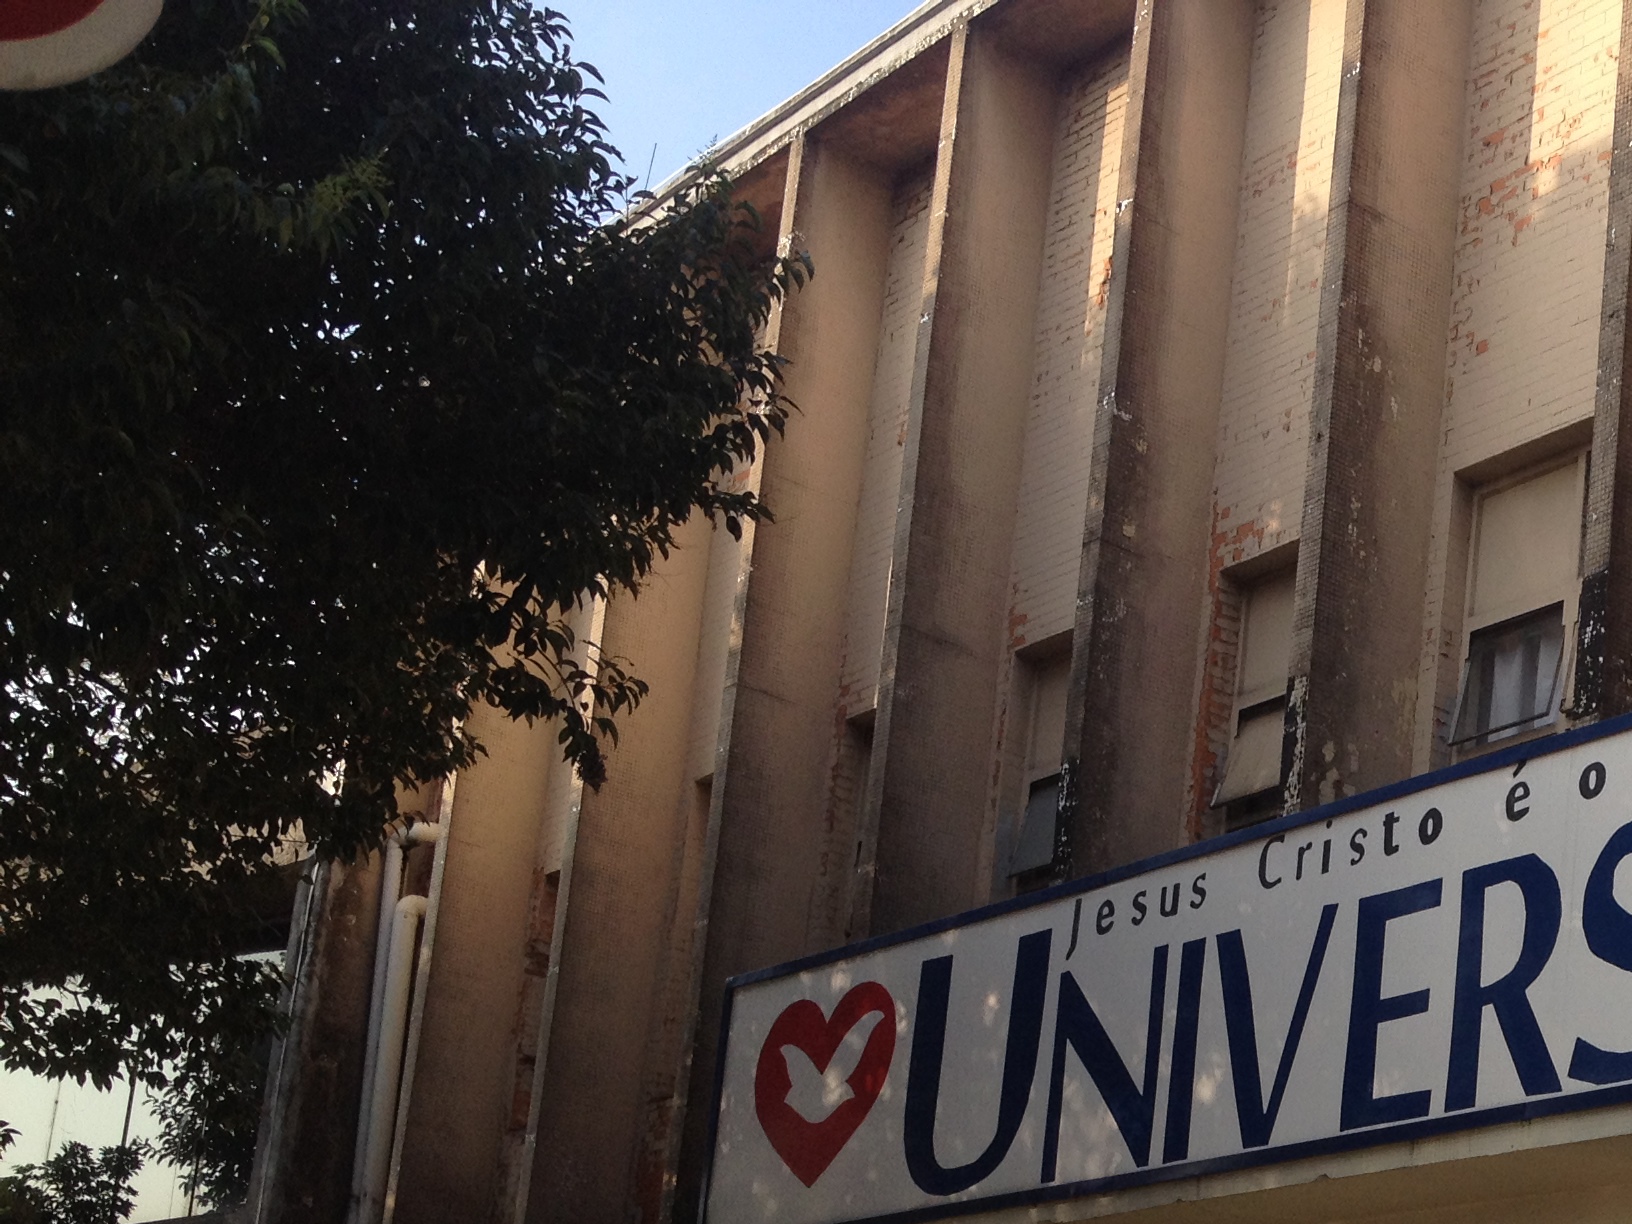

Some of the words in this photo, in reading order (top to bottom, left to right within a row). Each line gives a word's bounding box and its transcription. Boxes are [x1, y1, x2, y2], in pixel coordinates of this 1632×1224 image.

[1065, 871, 1208, 961] Jesus
[1257, 801, 1444, 890] Cristo
[1503, 762, 1532, 823] é
[1578, 758, 1608, 802] o
